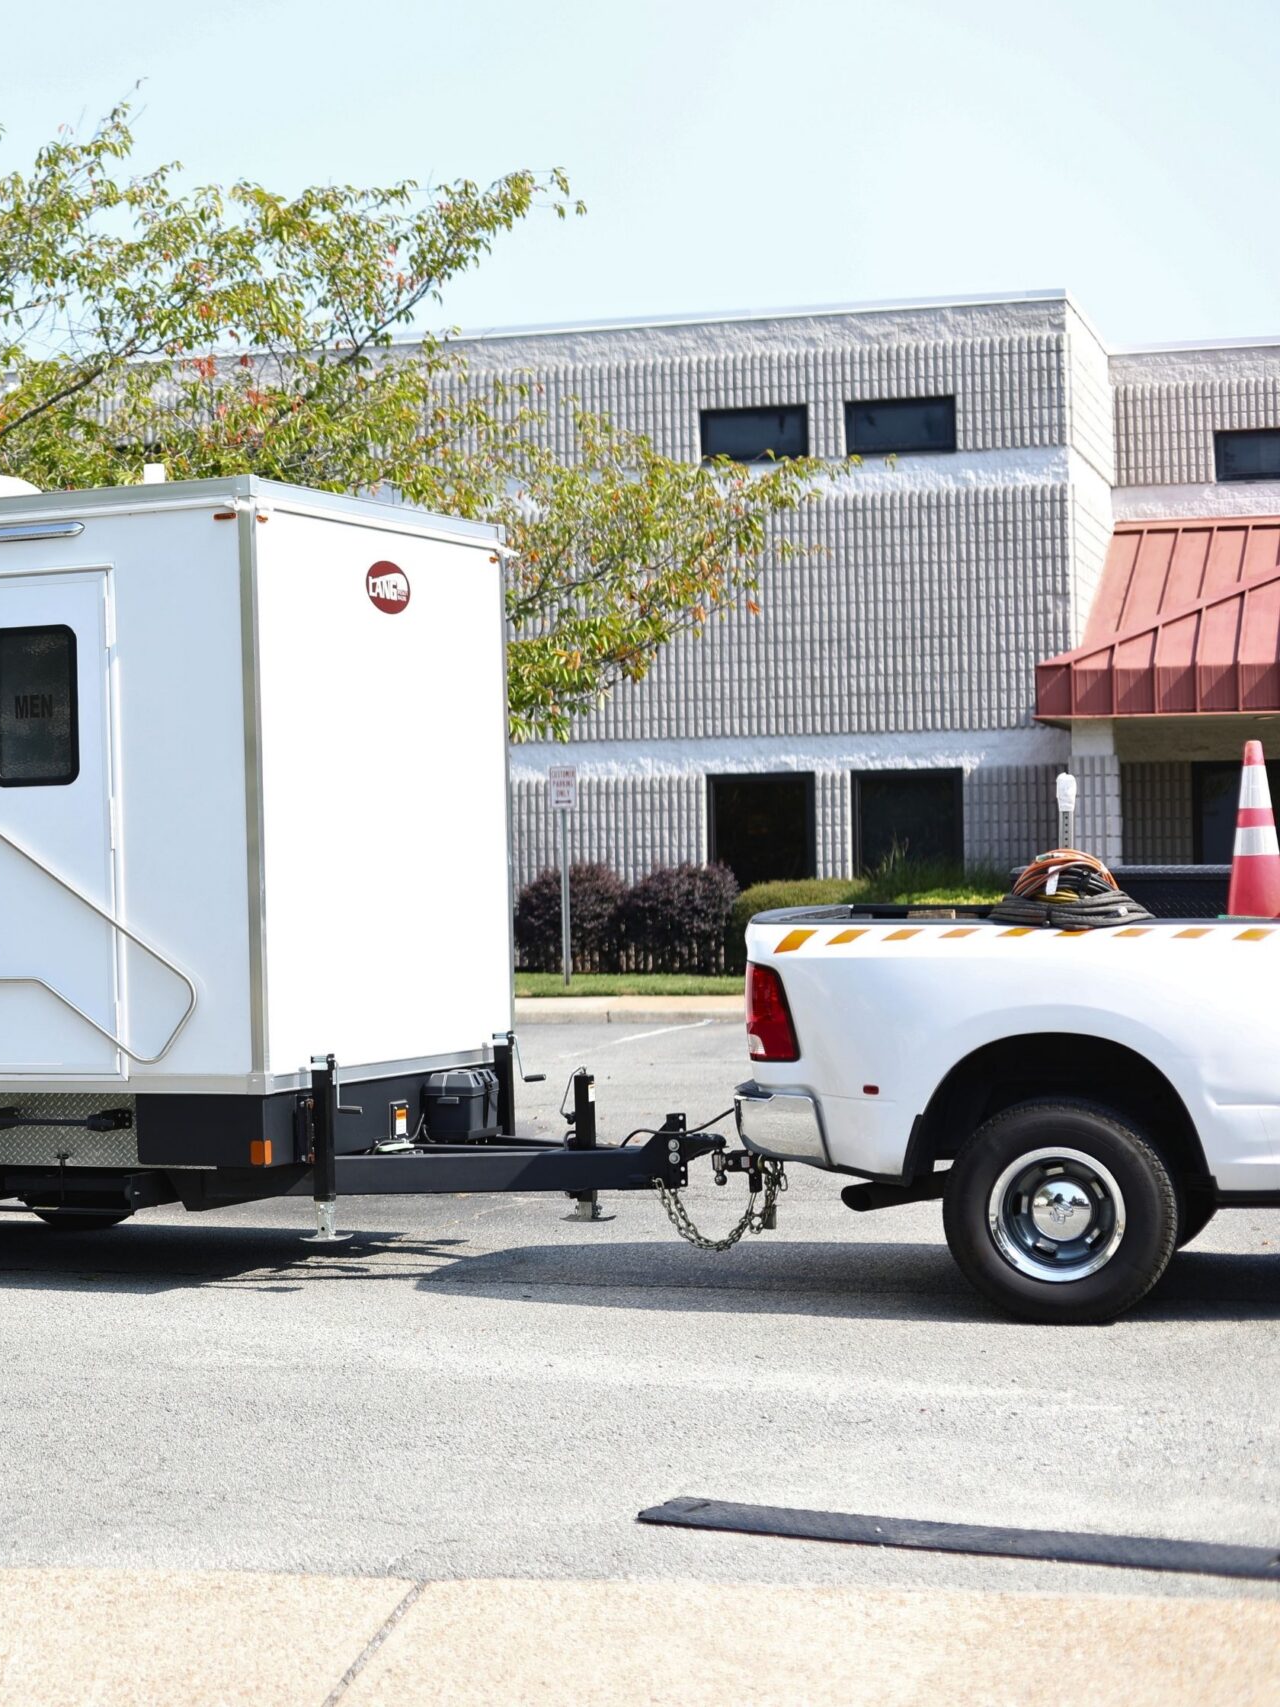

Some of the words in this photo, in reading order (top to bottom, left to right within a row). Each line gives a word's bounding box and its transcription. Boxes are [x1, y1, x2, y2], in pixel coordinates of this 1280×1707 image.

[368, 575, 398, 601] LANG
[14, 694, 53, 719] MEN
[552, 780, 574, 788] PARKING
[556, 789, 570, 797] ONLY
